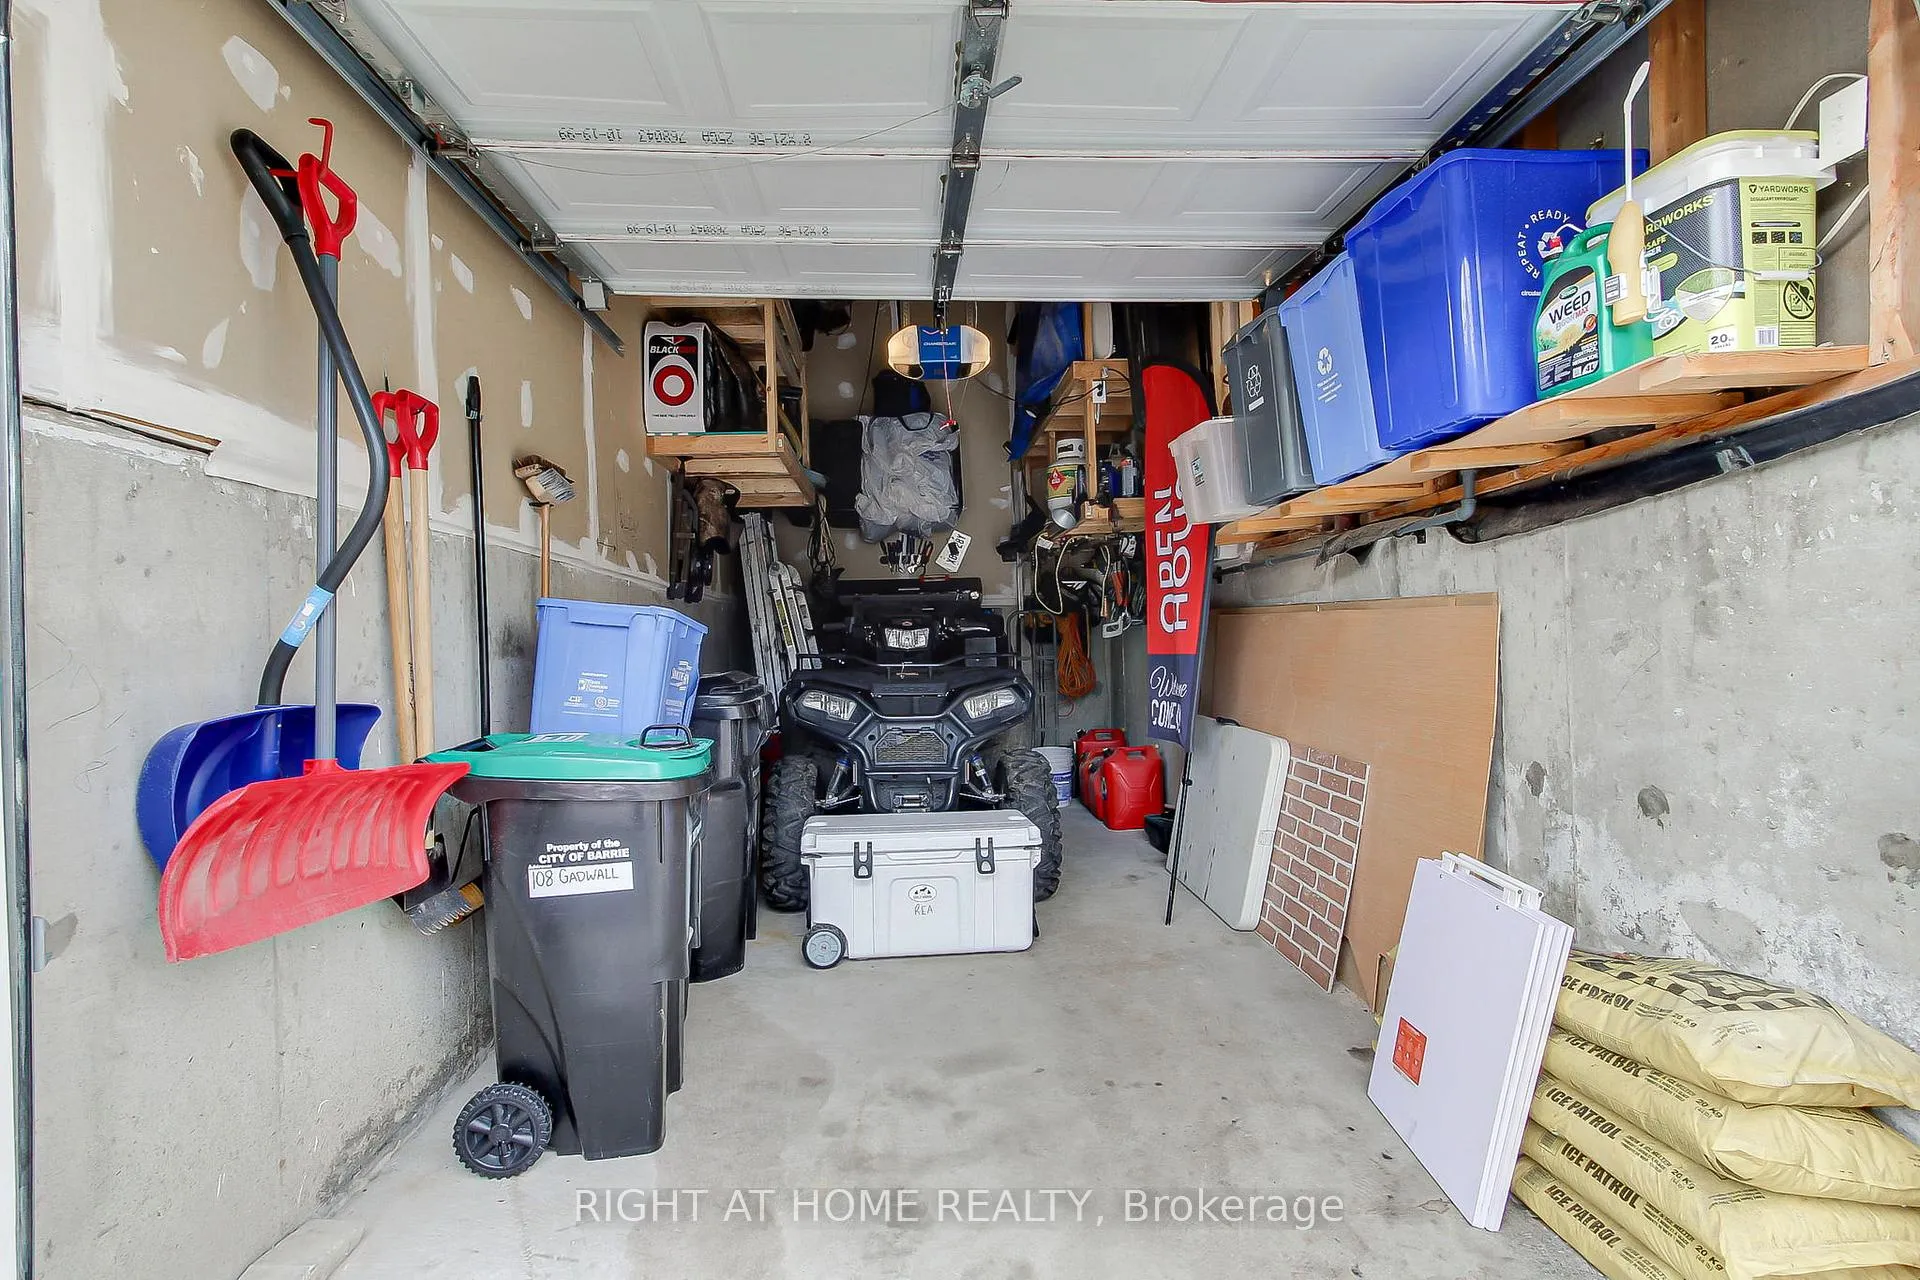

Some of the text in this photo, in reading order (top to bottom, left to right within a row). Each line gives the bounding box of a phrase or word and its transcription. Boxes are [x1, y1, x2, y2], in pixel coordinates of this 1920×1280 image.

[1758, 185, 1808, 193] YARDWORKS
[1645, 194, 1714, 235] RDWORKS
[1517, 209, 1571, 279] REPEAT READY
[1548, 290, 1591, 325] WEED
[1711, 333, 1728, 345] 20
[538, 847, 630, 864] CITY OF BARRIE
[546, 838, 621, 853] Property of the
[532, 867, 619, 890] 108 GADWALL
[914, 903, 933, 916] REA
[1561, 974, 1581, 991] CE
[1577, 982, 1635, 1011] PATROL
[1546, 1087, 1624, 1140] ICE PATROL
[1561, 1142, 1643, 1209] ICE PATROL
[1670, 1169, 1683, 1179] 20
[1682, 1176, 1696, 1190] Kg
[1545, 1185, 1622, 1249] ICE PATROL
[1694, 1246, 1725, 1272] 20 Kg
